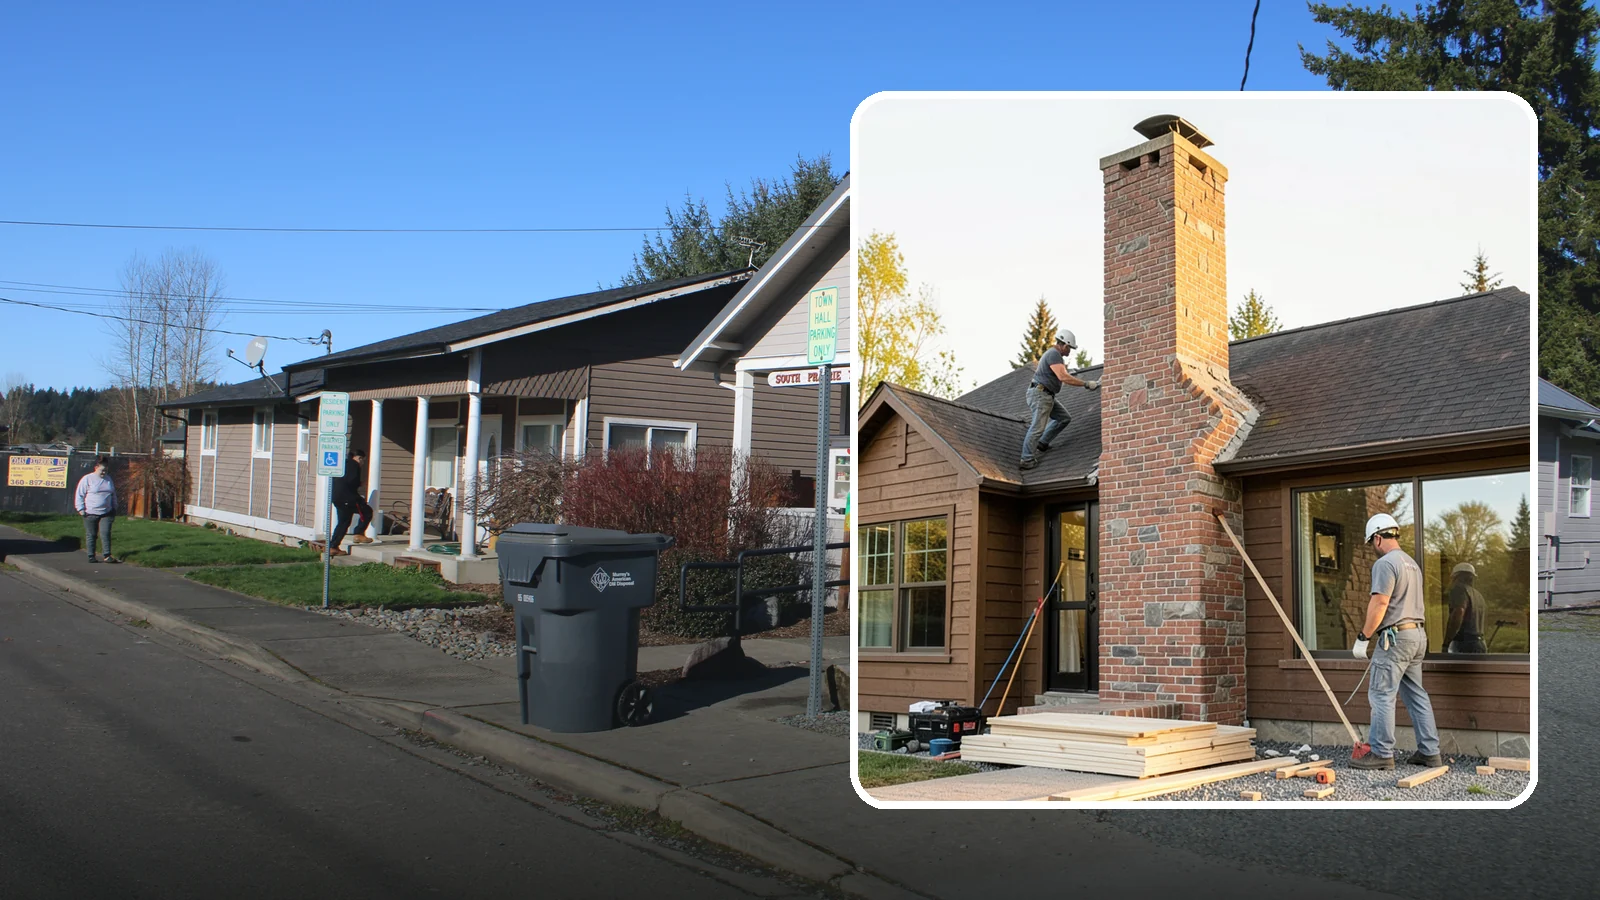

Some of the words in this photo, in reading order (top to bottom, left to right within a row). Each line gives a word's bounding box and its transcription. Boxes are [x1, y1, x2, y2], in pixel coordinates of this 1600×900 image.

[815, 294, 833, 308] TOWN
[814, 311, 831, 324] HALL
[810, 326, 836, 340] PARKING
[813, 344, 831, 357] ONLY
[775, 373, 801, 384] SOUTH
